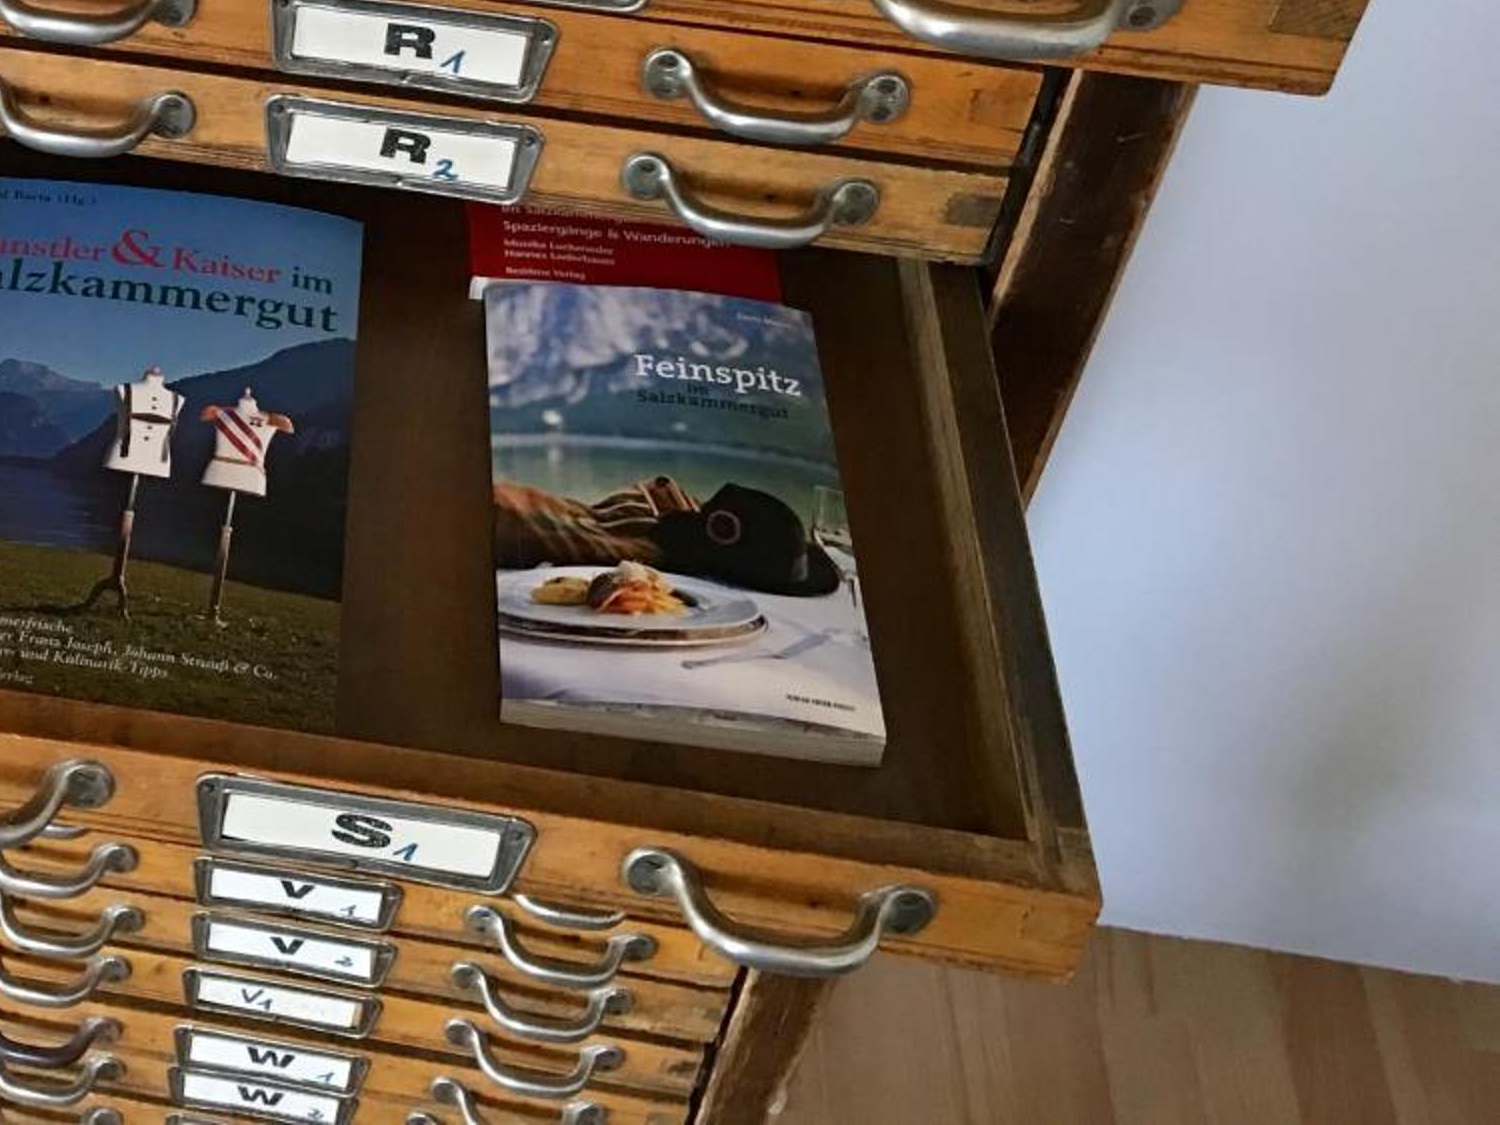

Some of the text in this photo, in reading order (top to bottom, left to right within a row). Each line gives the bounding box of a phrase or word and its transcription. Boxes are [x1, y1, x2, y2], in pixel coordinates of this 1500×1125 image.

[383, 22, 466, 74] R 1
[379, 128, 459, 181] R 2
[111, 228, 164, 270] &
[171, 245, 282, 285] Kaiser
[291, 265, 334, 295] im
[634, 354, 803, 399] Feinspitz
[331, 813, 419, 862] S 1
[280, 879, 315, 900] V
[270, 936, 305, 956] V
[246, 1046, 296, 1069] W
[236, 1084, 285, 1106] W
